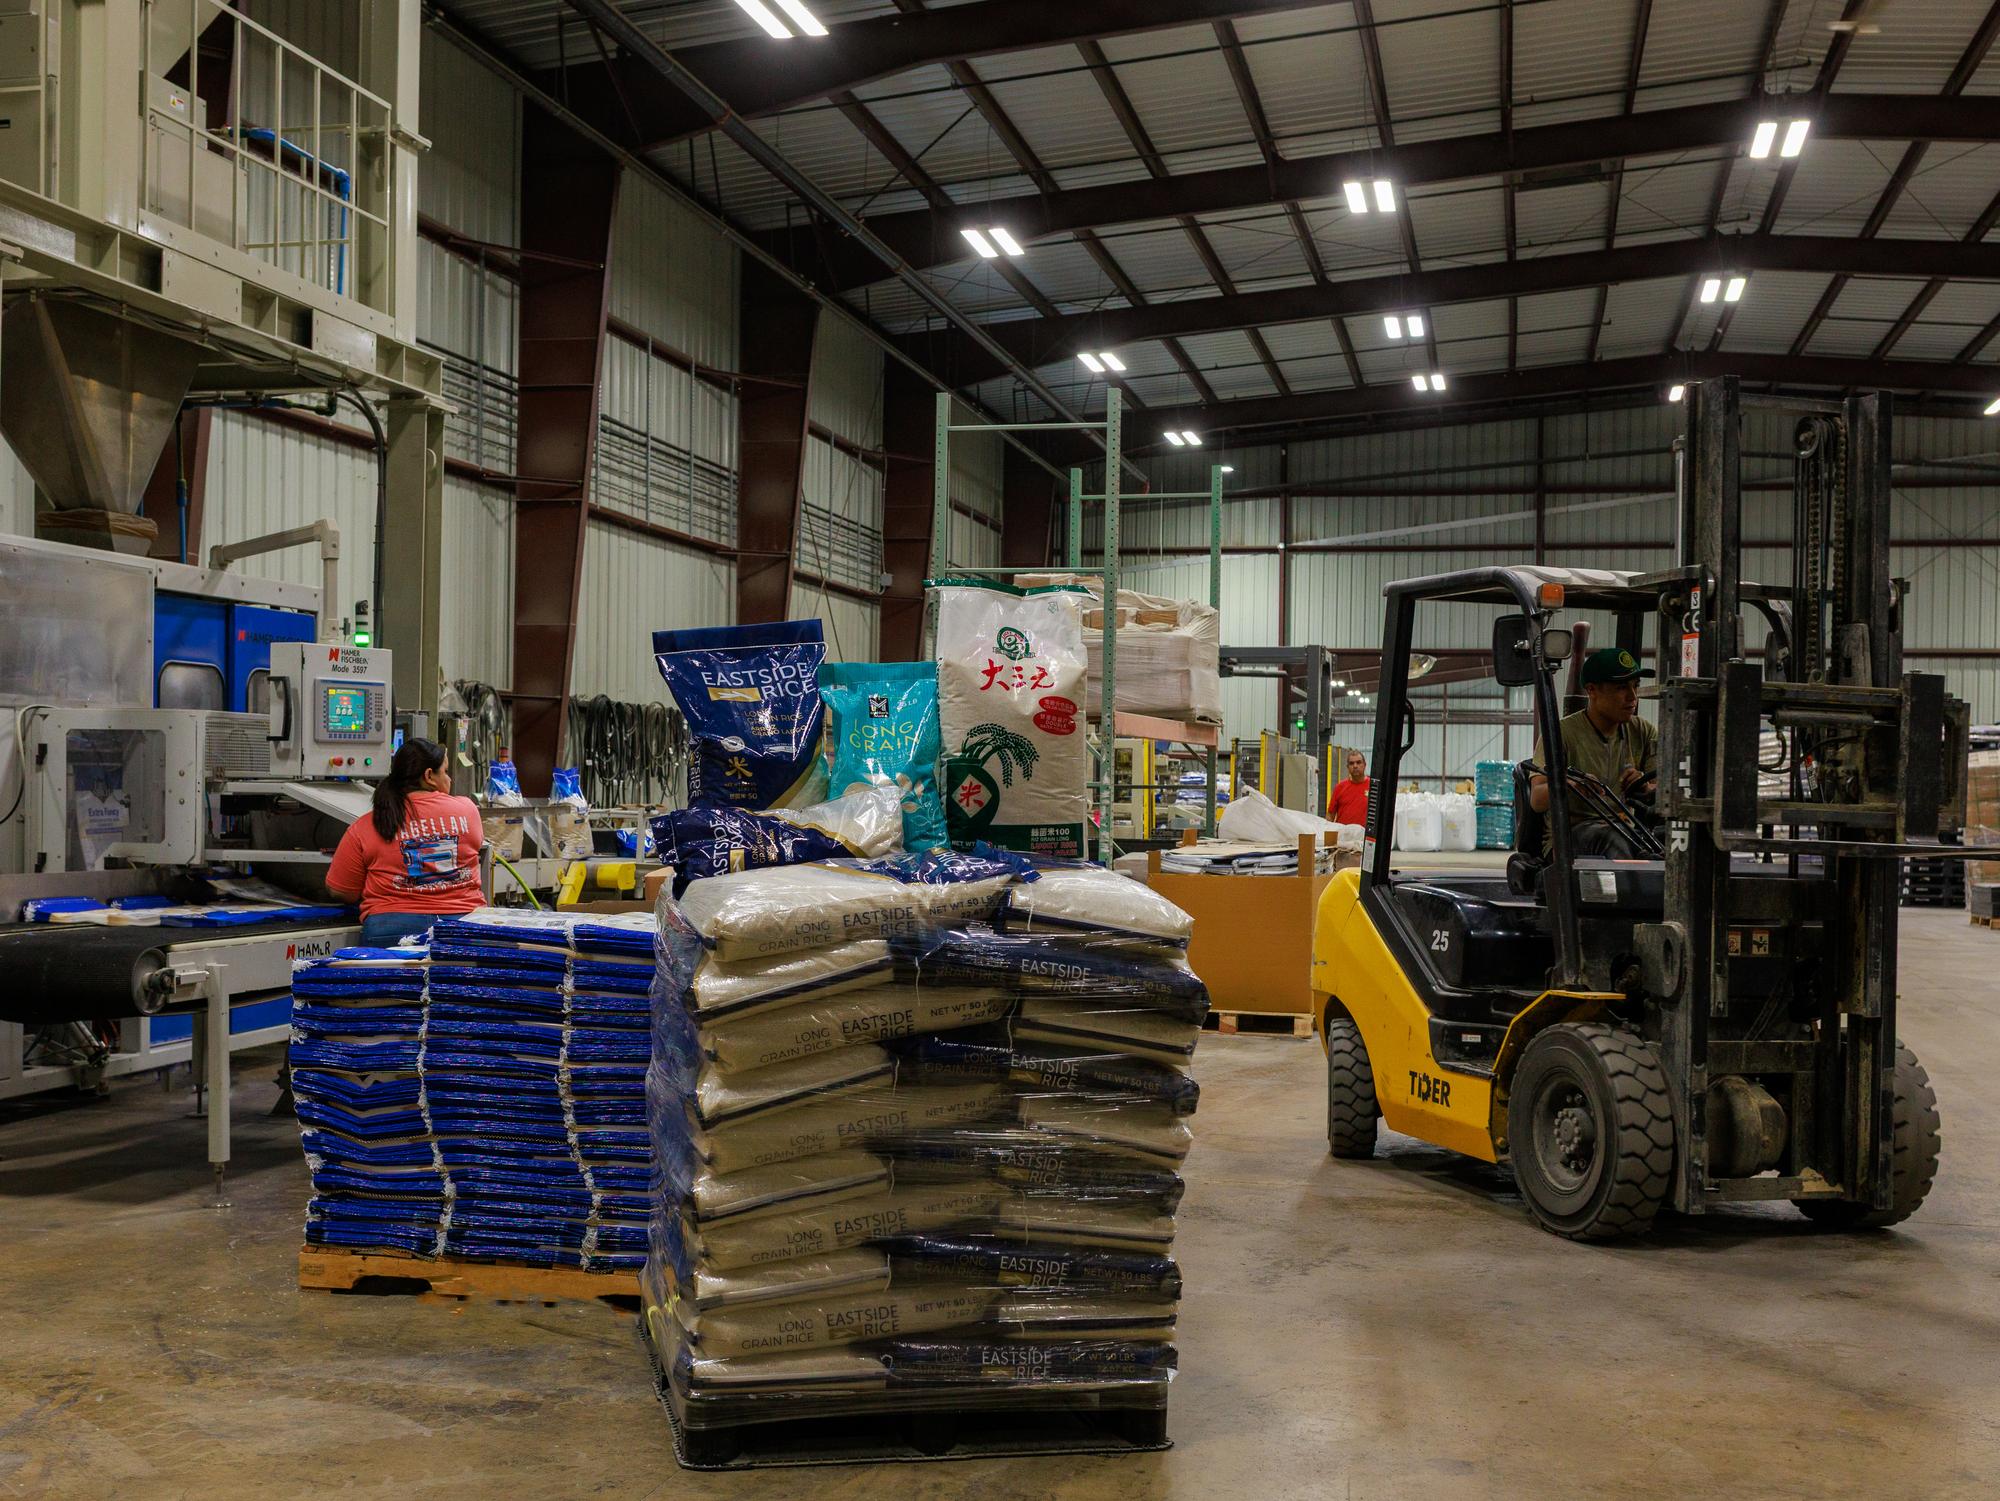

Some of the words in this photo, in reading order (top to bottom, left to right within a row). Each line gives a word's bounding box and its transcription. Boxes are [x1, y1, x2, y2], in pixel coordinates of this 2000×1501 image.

[341, 649, 360, 657] HAMER
[352, 665, 368, 675] 3597
[701, 662, 813, 687] EASTSIDE
[760, 679, 817, 700] RICE
[779, 712, 804, 722] RICE
[854, 718, 914, 738] LONG
[849, 732, 920, 752] GRAIN
[724, 756, 753, 780] 米
[958, 781, 985, 808] 米
[88, 807, 104, 817] Extra
[395, 815, 469, 841] AGELLAN
[710, 820, 728, 876] ASTSIDE
[929, 906, 947, 916] NET
[949, 902, 965, 911] WT
[967, 899, 979, 907] 50
[843, 906, 914, 928] EASTSIDE
[795, 920, 831, 935] LONG
[880, 921, 915, 936] RICE
[759, 938, 800, 953] GRAIN
[803, 933, 832, 945] RICE
[1431, 929, 1450, 951] 25
[1021, 958, 1092, 981] EASTSIDE
[1155, 982, 1173, 994] LBS
[930, 1005, 950, 1017] NET
[952, 1003, 967, 1012] WT
[969, 1000, 981, 1009] 50
[842, 1009, 914, 1034] EASTSIDE
[795, 1027, 831, 1044] LONG
[880, 1024, 915, 1039] RICE
[760, 1046, 800, 1062] GRAIN
[803, 1038, 832, 1053] RICE
[1010, 1052, 1080, 1077] EASTSIDE
[1040, 1073, 1077, 1091] RICE
[1094, 1071, 1113, 1081] NET
[1130, 1077, 1141, 1087] 50
[837, 1110, 909, 1137] EASTSIDE
[790, 1132, 826, 1148] LONG
[755, 1149, 795, 1164] GRAIN
[1000, 1152, 1067, 1176] EASTSIDE
[1029, 1171, 1064, 1186] RICE
[834, 1208, 907, 1236] EASTSIDE
[787, 1228, 822, 1244] LONG
[751, 1248, 792, 1263] GRAIN
[1000, 1255, 1070, 1276] EASTSIDE
[1083, 1266, 1102, 1277] NET
[1104, 1268, 1119, 1279] WT
[1121, 1270, 1133, 1281] 50
[1134, 1271, 1152, 1282] LBS
[1031, 1273, 1065, 1288] RICE
[826, 1304, 899, 1327] EASTSIDE
[915, 1302, 935, 1313] NET
[779, 1319, 814, 1333] LONG
[864, 1319, 900, 1336] RICE
[741, 1335, 782, 1350] GRAIN
[786, 1331, 815, 1345] RICE
[982, 1351, 1051, 1365] EASTSIDE
[1017, 1365, 1050, 1379] RICE
